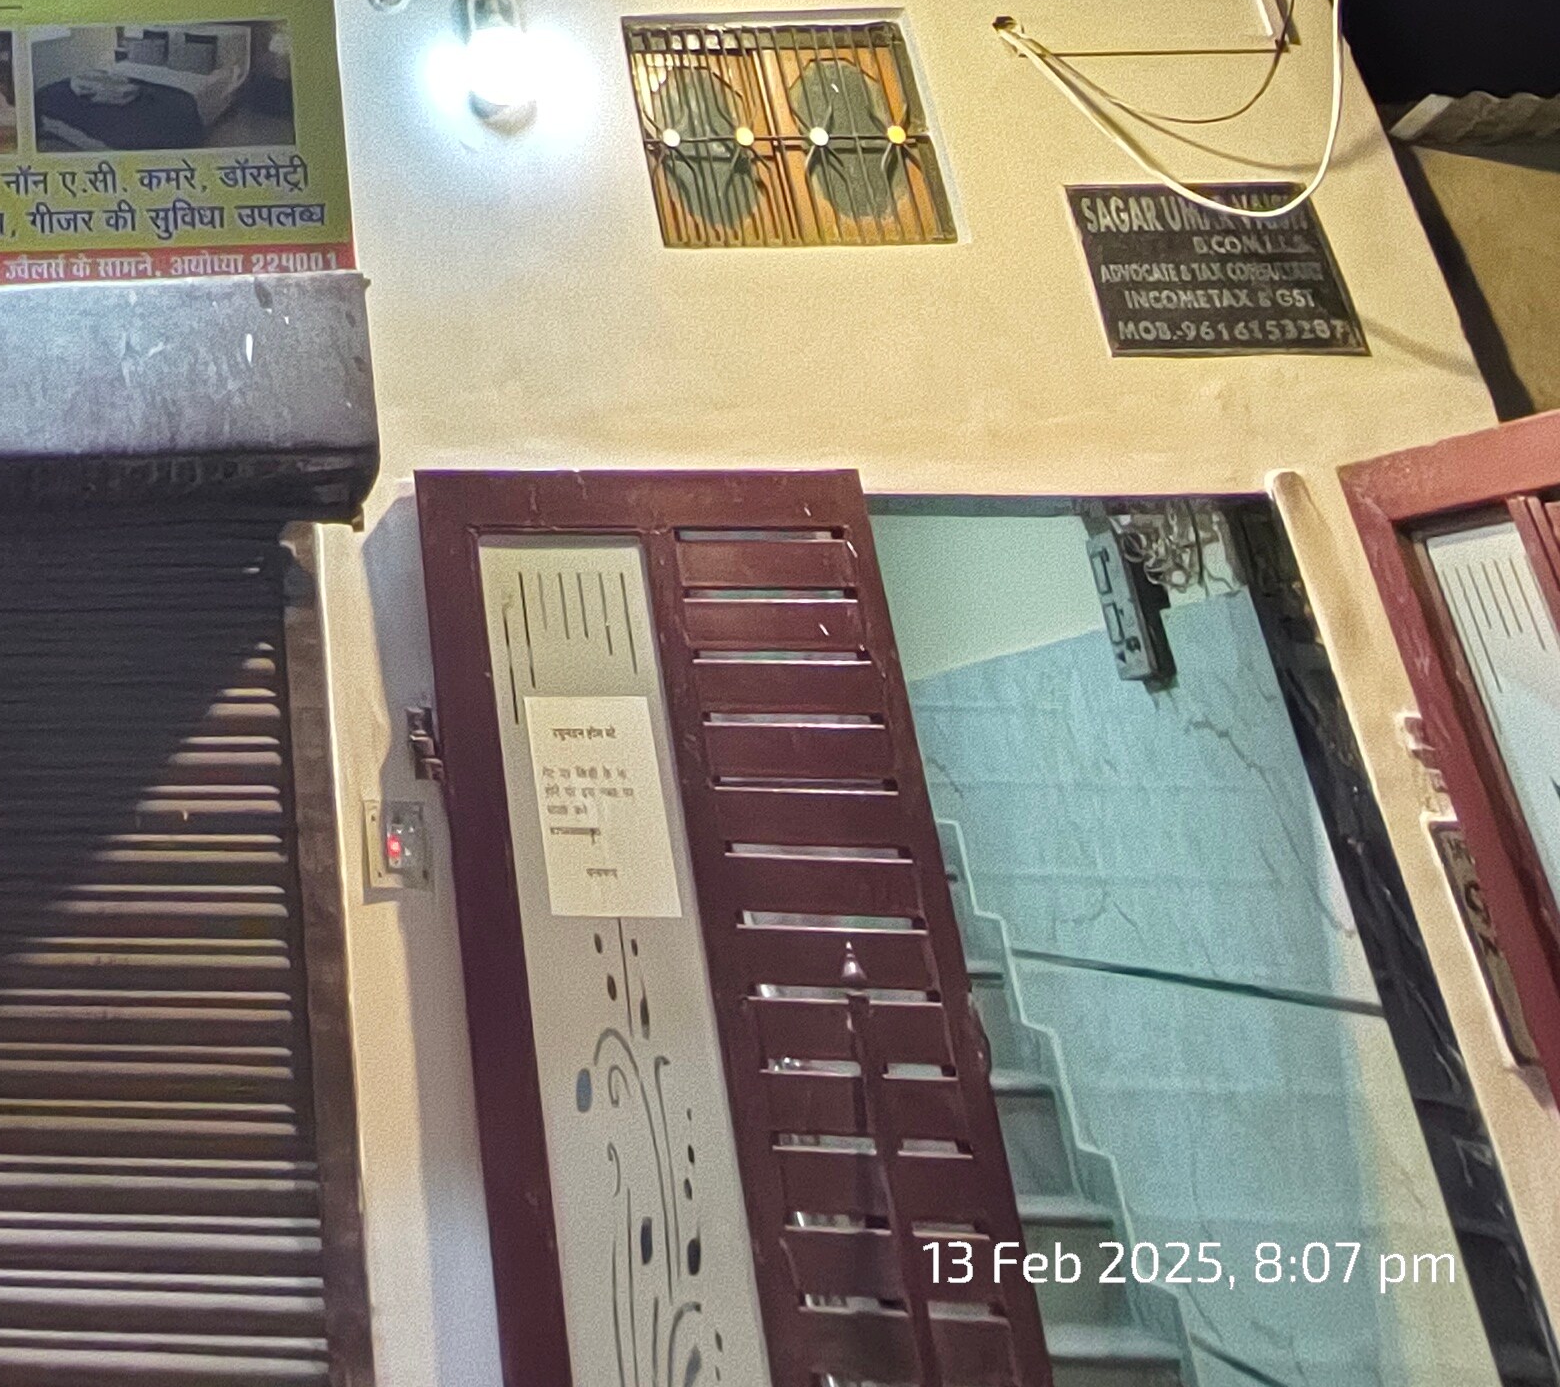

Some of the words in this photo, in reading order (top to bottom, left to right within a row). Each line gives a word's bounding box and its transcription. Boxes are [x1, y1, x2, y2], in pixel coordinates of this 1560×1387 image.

[1, 164, 49, 195] नॉन
[26, 201, 93, 235] गीजर
[103, 199, 136, 232] की
[146, 197, 224, 240] सुविधा
[1079, 195, 1164, 234] SAGAR
[1100, 263, 1180, 284] ADVOCATE
[1192, 263, 1223, 282] TAX
[1276, 289, 1316, 308] GST
